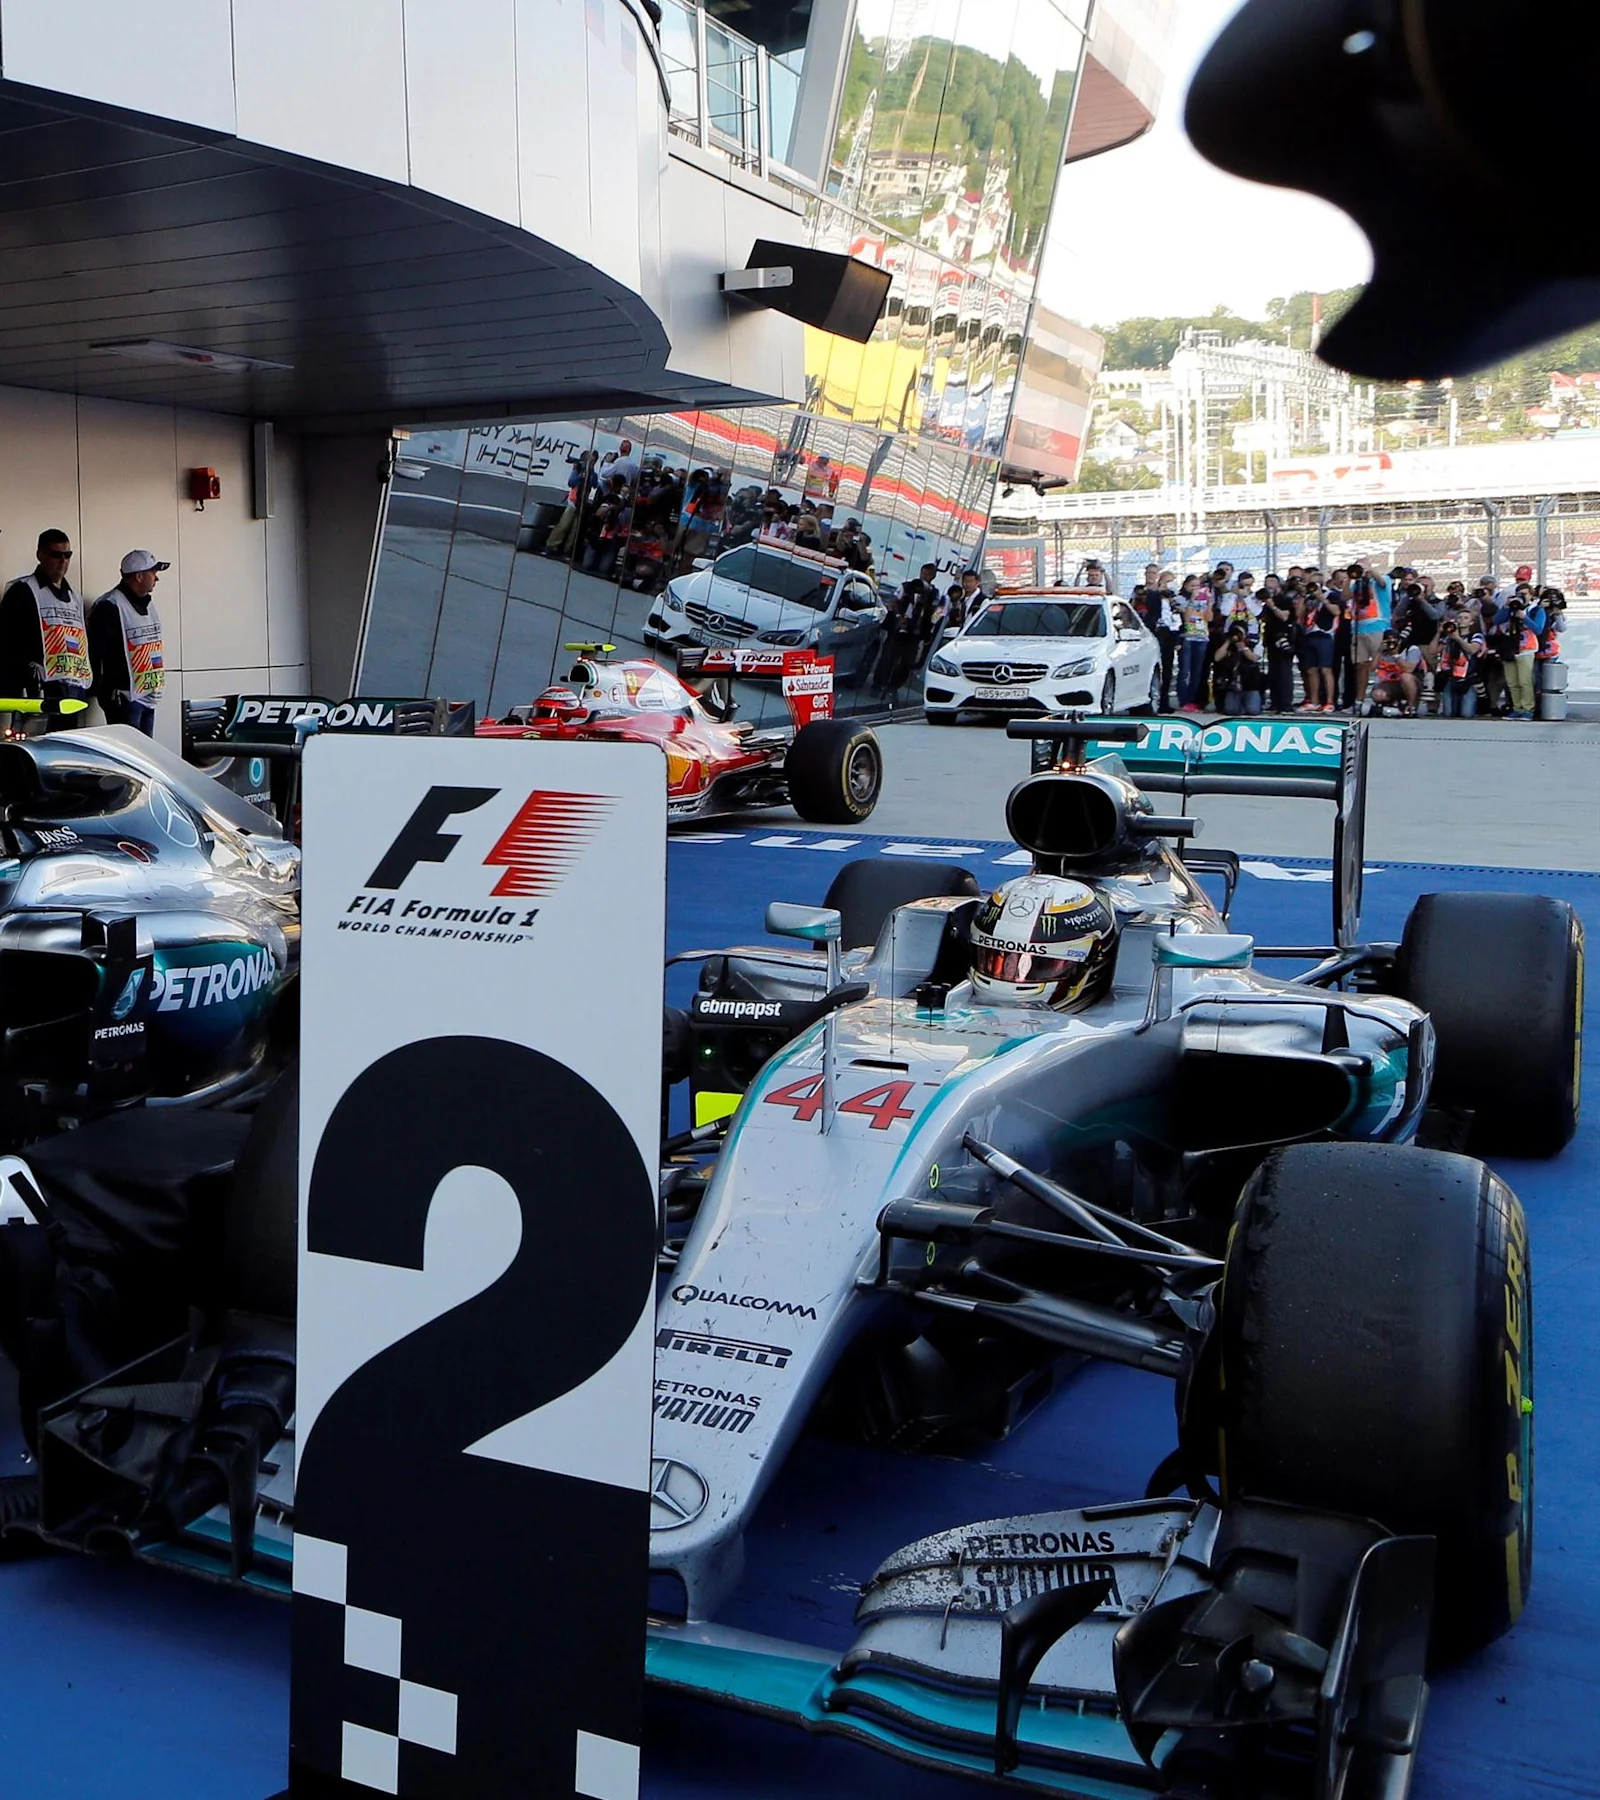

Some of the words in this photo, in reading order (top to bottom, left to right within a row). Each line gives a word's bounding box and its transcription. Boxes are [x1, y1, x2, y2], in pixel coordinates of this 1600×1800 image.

[796, 676, 831, 693] Santander
[803, 663, 831, 675] V-Power
[237, 701, 394, 727] PETRONA
[1097, 724, 1344, 758] TRONAS
[35, 826, 79, 845] BOSS
[364, 785, 623, 898] F1
[337, 920, 390, 934] WORLD
[347, 895, 396, 916] FIA
[401, 900, 516, 926] Formula
[519, 908, 540, 927] 1
[979, 935, 1048, 956] PETRONAS
[149, 942, 276, 1012] PETRONAS
[699, 1000, 783, 1020] ebmpapst
[95, 1021, 145, 1040] PETRONAS
[763, 1073, 918, 1131] 44
[293, 1035, 658, 1575] 2
[671, 1284, 818, 1320] QUALCOMM
[1503, 1202, 1528, 1420] ZERO
[655, 1328, 793, 1369] PIRELLI
[654, 1395, 756, 1435] YNTIUM
[1505, 1451, 1522, 1504] P
[966, 1531, 1115, 1559] PETRONAS
